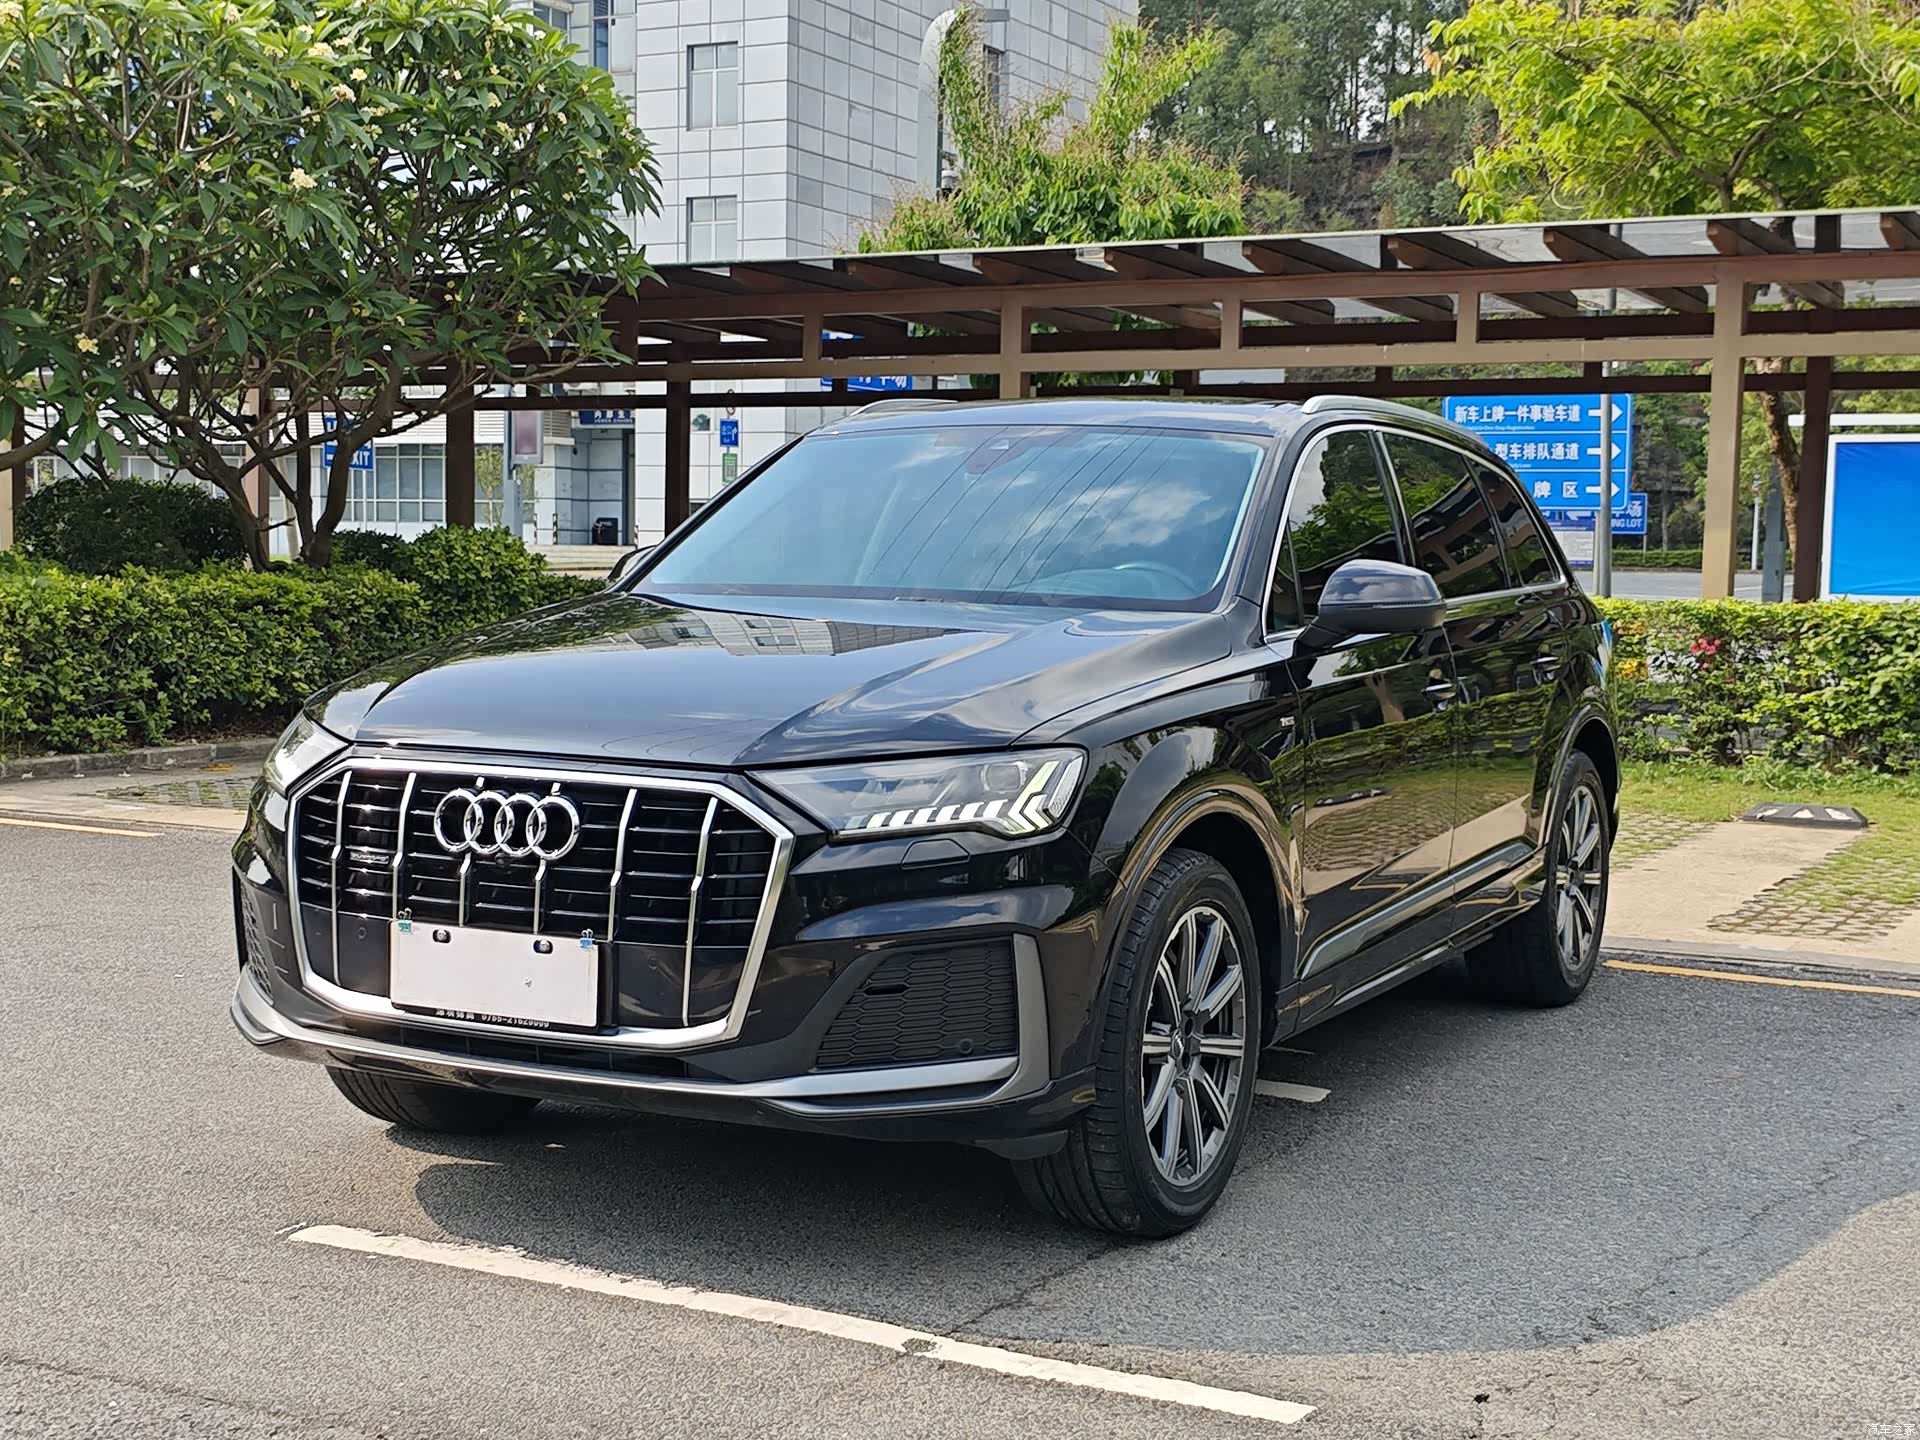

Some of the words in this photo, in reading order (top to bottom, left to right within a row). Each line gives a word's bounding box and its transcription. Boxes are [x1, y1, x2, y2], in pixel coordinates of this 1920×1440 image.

[1454, 405, 1580, 423] 新车上牌一件事验车道
[1626, 519, 1642, 528] LOT
